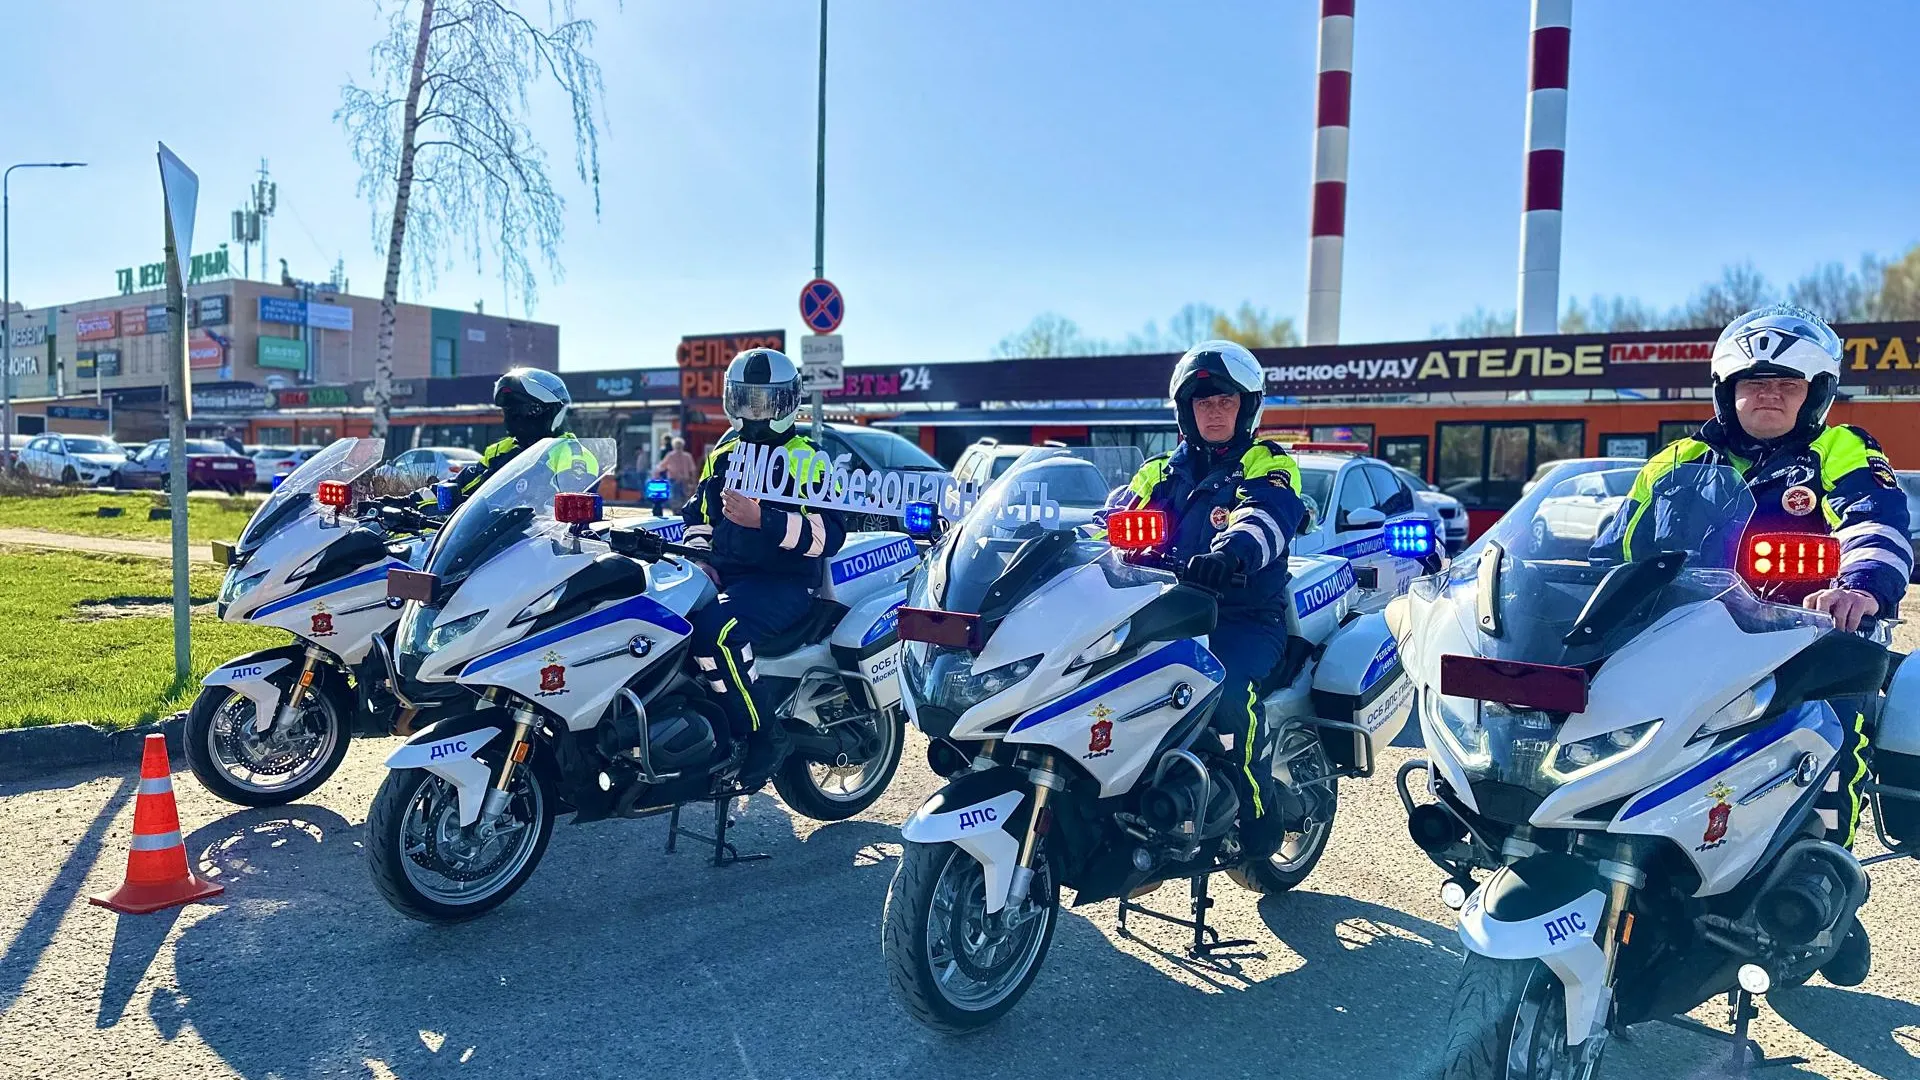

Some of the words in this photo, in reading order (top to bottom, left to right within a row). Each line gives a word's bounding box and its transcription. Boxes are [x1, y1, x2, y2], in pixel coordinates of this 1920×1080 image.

[1417, 345, 1604, 380] АТЕЛЬЕ
[1611, 343, 1715, 361] ПАРИКМ
[1844, 336, 1920, 370] ТА
[900, 366, 932, 391] 24
[723, 441, 1060, 527] #МОТОбезопаснсть
[842, 540, 912, 578] ПОЛИЦИЯ
[1303, 565, 1353, 610] ПОЛИЦИЯ
[231, 666, 262, 680] ДПС
[871, 657, 892, 675] ОСБ
[1367, 704, 1384, 725] ОСБ
[1384, 691, 1398, 713] ДПС
[430, 740, 468, 760] ДПС
[959, 807, 998, 830] ДПС
[1543, 911, 1587, 946] ДПС
